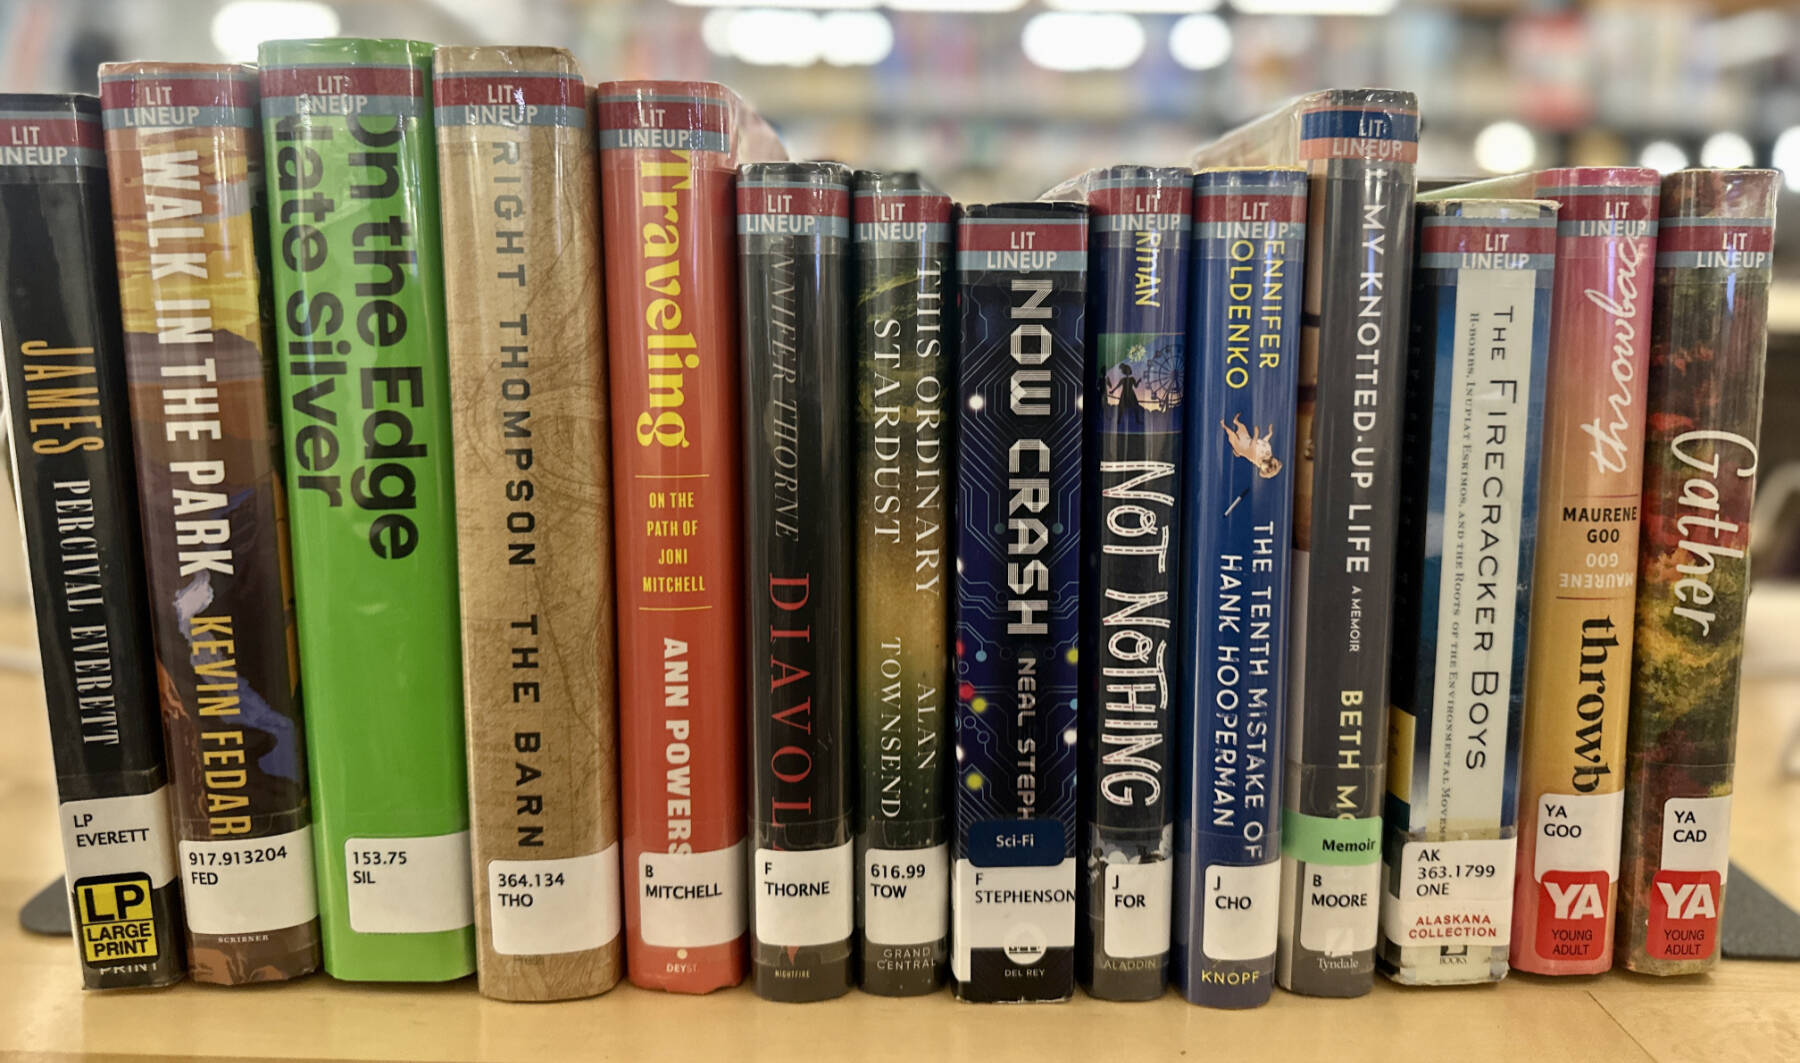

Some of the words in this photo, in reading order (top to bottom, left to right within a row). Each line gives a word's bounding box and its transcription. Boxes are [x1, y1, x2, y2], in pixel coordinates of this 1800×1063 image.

[318, 75, 343, 94] LIT
[146, 86, 172, 105] LIT
[487, 85, 513, 103] LIT
[295, 95, 368, 114] LINEUP
[124, 106, 200, 127] LINEUP
[465, 105, 538, 124] LINEUP
[640, 109, 665, 127] LIT
[11, 126, 40, 145] LIT
[1359, 120, 1383, 138] LIT
[619, 129, 688, 149] LINEUP
[1332, 139, 1403, 157] LINEUP
[492, 127, 526, 287] RIGHT
[767, 195, 792, 213] LIT
[881, 203, 905, 221] LIT
[1136, 195, 1161, 212] LIT
[1242, 202, 1269, 220] LIT
[1605, 202, 1629, 219] LIT
[142, 150, 209, 281] WALK
[746, 214, 816, 233] LINEUP
[1112, 213, 1180, 231] LINEUP
[860, 222, 927, 241] LINEUP
[1217, 222, 1288, 239] LINEUP
[1362, 204, 1385, 255] MY
[1580, 220, 1647, 237] LINEUP
[1011, 232, 1035, 250] LIT
[1485, 234, 1509, 252] LIT
[1723, 233, 1748, 250] LIT
[987, 251, 1057, 269] LINEUP
[1462, 253, 1530, 270] LINEUP
[1697, 251, 1765, 269] LINEUP
[352, 215, 418, 348] the
[636, 150, 700, 449] Traveling
[916, 261, 942, 359] THIS
[1225, 240, 1254, 389] OLDENKO
[155, 299, 214, 345] IN
[1491, 305, 1514, 360] THE
[20, 340, 105, 455] JAMES
[161, 358, 222, 442] THE
[286, 289, 352, 508] Silver
[499, 313, 537, 566] THOMPSON
[873, 319, 902, 544] STARDUST
[350, 366, 428, 560] Edge
[772, 399, 799, 542] THORNE
[915, 375, 942, 597] ORDINARY
[649, 492, 665, 508] ON
[670, 491, 695, 508] THE
[169, 461, 234, 577] PARK
[1100, 460, 1176, 574] NOT
[1473, 380, 1517, 652] FIRECRACKER
[1562, 506, 1638, 522] MAURENE
[647, 520, 679, 537] PATH
[682, 519, 698, 536] OF
[1008, 438, 1050, 635] CRASH
[1586, 528, 1620, 543] GOO
[1670, 430, 1759, 637] Gather
[53, 479, 104, 613] PERCIVAL
[1252, 521, 1274, 573] THE
[1346, 504, 1373, 573] LIFE
[658, 548, 688, 565] JONI
[1586, 553, 1618, 568] GOO
[642, 575, 706, 593] MITCHELL
[1351, 585, 1362, 594] A
[1559, 573, 1634, 588] MAURENE
[1218, 554, 1243, 632] HANK
[1249, 585, 1272, 676] TENTH
[1348, 602, 1362, 652] MEMOIR
[189, 615, 241, 716] KEVIN
[511, 614, 540, 704] THE
[664, 637, 690, 708] ANN
[70, 623, 119, 746] EVERETT
[1017, 657, 1036, 728] NEAL
[1100, 587, 1172, 807] NOTHING
[1571, 615, 1620, 793] throwb
[768, 572, 813, 850] DIAVOL
[1465, 670, 1500, 770] BOYS
[880, 636, 902, 818] TOWNSEND
[917, 682, 936, 770] ALAN
[1338, 690, 1363, 769] BETH
[1213, 645, 1240, 828] HOOPERMAN
[201, 730, 252, 837] FEDAR
[514, 732, 544, 848] BARN
[664, 720, 693, 855] POWERS
[1545, 803, 1568, 818] YA
[1674, 810, 1696, 824] YA
[73, 813, 93, 829] LP
[76, 828, 150, 847] EVERETT
[1243, 820, 1264, 859] OF
[1543, 824, 1583, 838] GOO
[1673, 829, 1708, 843] CAD
[996, 834, 1035, 848] Sci-Fi
[1322, 838, 1376, 852] Memoir
[188, 845, 288, 866] 917.913204
[353, 850, 407, 865] 153.75
[1417, 849, 1440, 862] AK
[645, 865, 654, 878] B
[764, 862, 773, 875] F
[871, 864, 926, 880] 616.99
[1417, 864, 1496, 880] 363.1799
[191, 871, 219, 886] FED
[353, 871, 376, 885] SIL
[498, 872, 565, 888] 364.134
[975, 872, 984, 886] F
[1112, 875, 1120, 890] J
[1213, 876, 1221, 891] J
[1312, 874, 1322, 887] B
[645, 883, 722, 900] MITCHELL
[764, 882, 830, 898] THORNE
[871, 885, 907, 899] TOW
[975, 888, 1076, 904] STEPHENSON
[1416, 883, 1449, 897] ONE
[83, 884, 146, 923] LP
[498, 893, 534, 908] THO
[1115, 894, 1146, 908] FOR
[1215, 895, 1252, 910] CHO
[1311, 893, 1367, 907] MOORE
[1543, 882, 1605, 921] YA
[1656, 881, 1717, 920] YA
[1416, 914, 1492, 926] ALASKANA
[87, 923, 153, 942] LARGE
[1408, 926, 1498, 940] COLLECTION
[1551, 929, 1593, 942] YOUNG
[1664, 929, 1705, 942] YOUNG
[94, 940, 148, 957] PRINT
[883, 947, 931, 959] GRAND
[1552, 944, 1590, 956] ADULT
[1664, 944, 1702, 956] ADULT
[876, 957, 936, 971] CENTRAL
[1004, 969, 1024, 977] DEL
[1026, 969, 1045, 977] REY
[1103, 959, 1157, 971] ALADDIN
[1316, 957, 1359, 971] Tyndale
[1201, 970, 1260, 985] KNOPF
